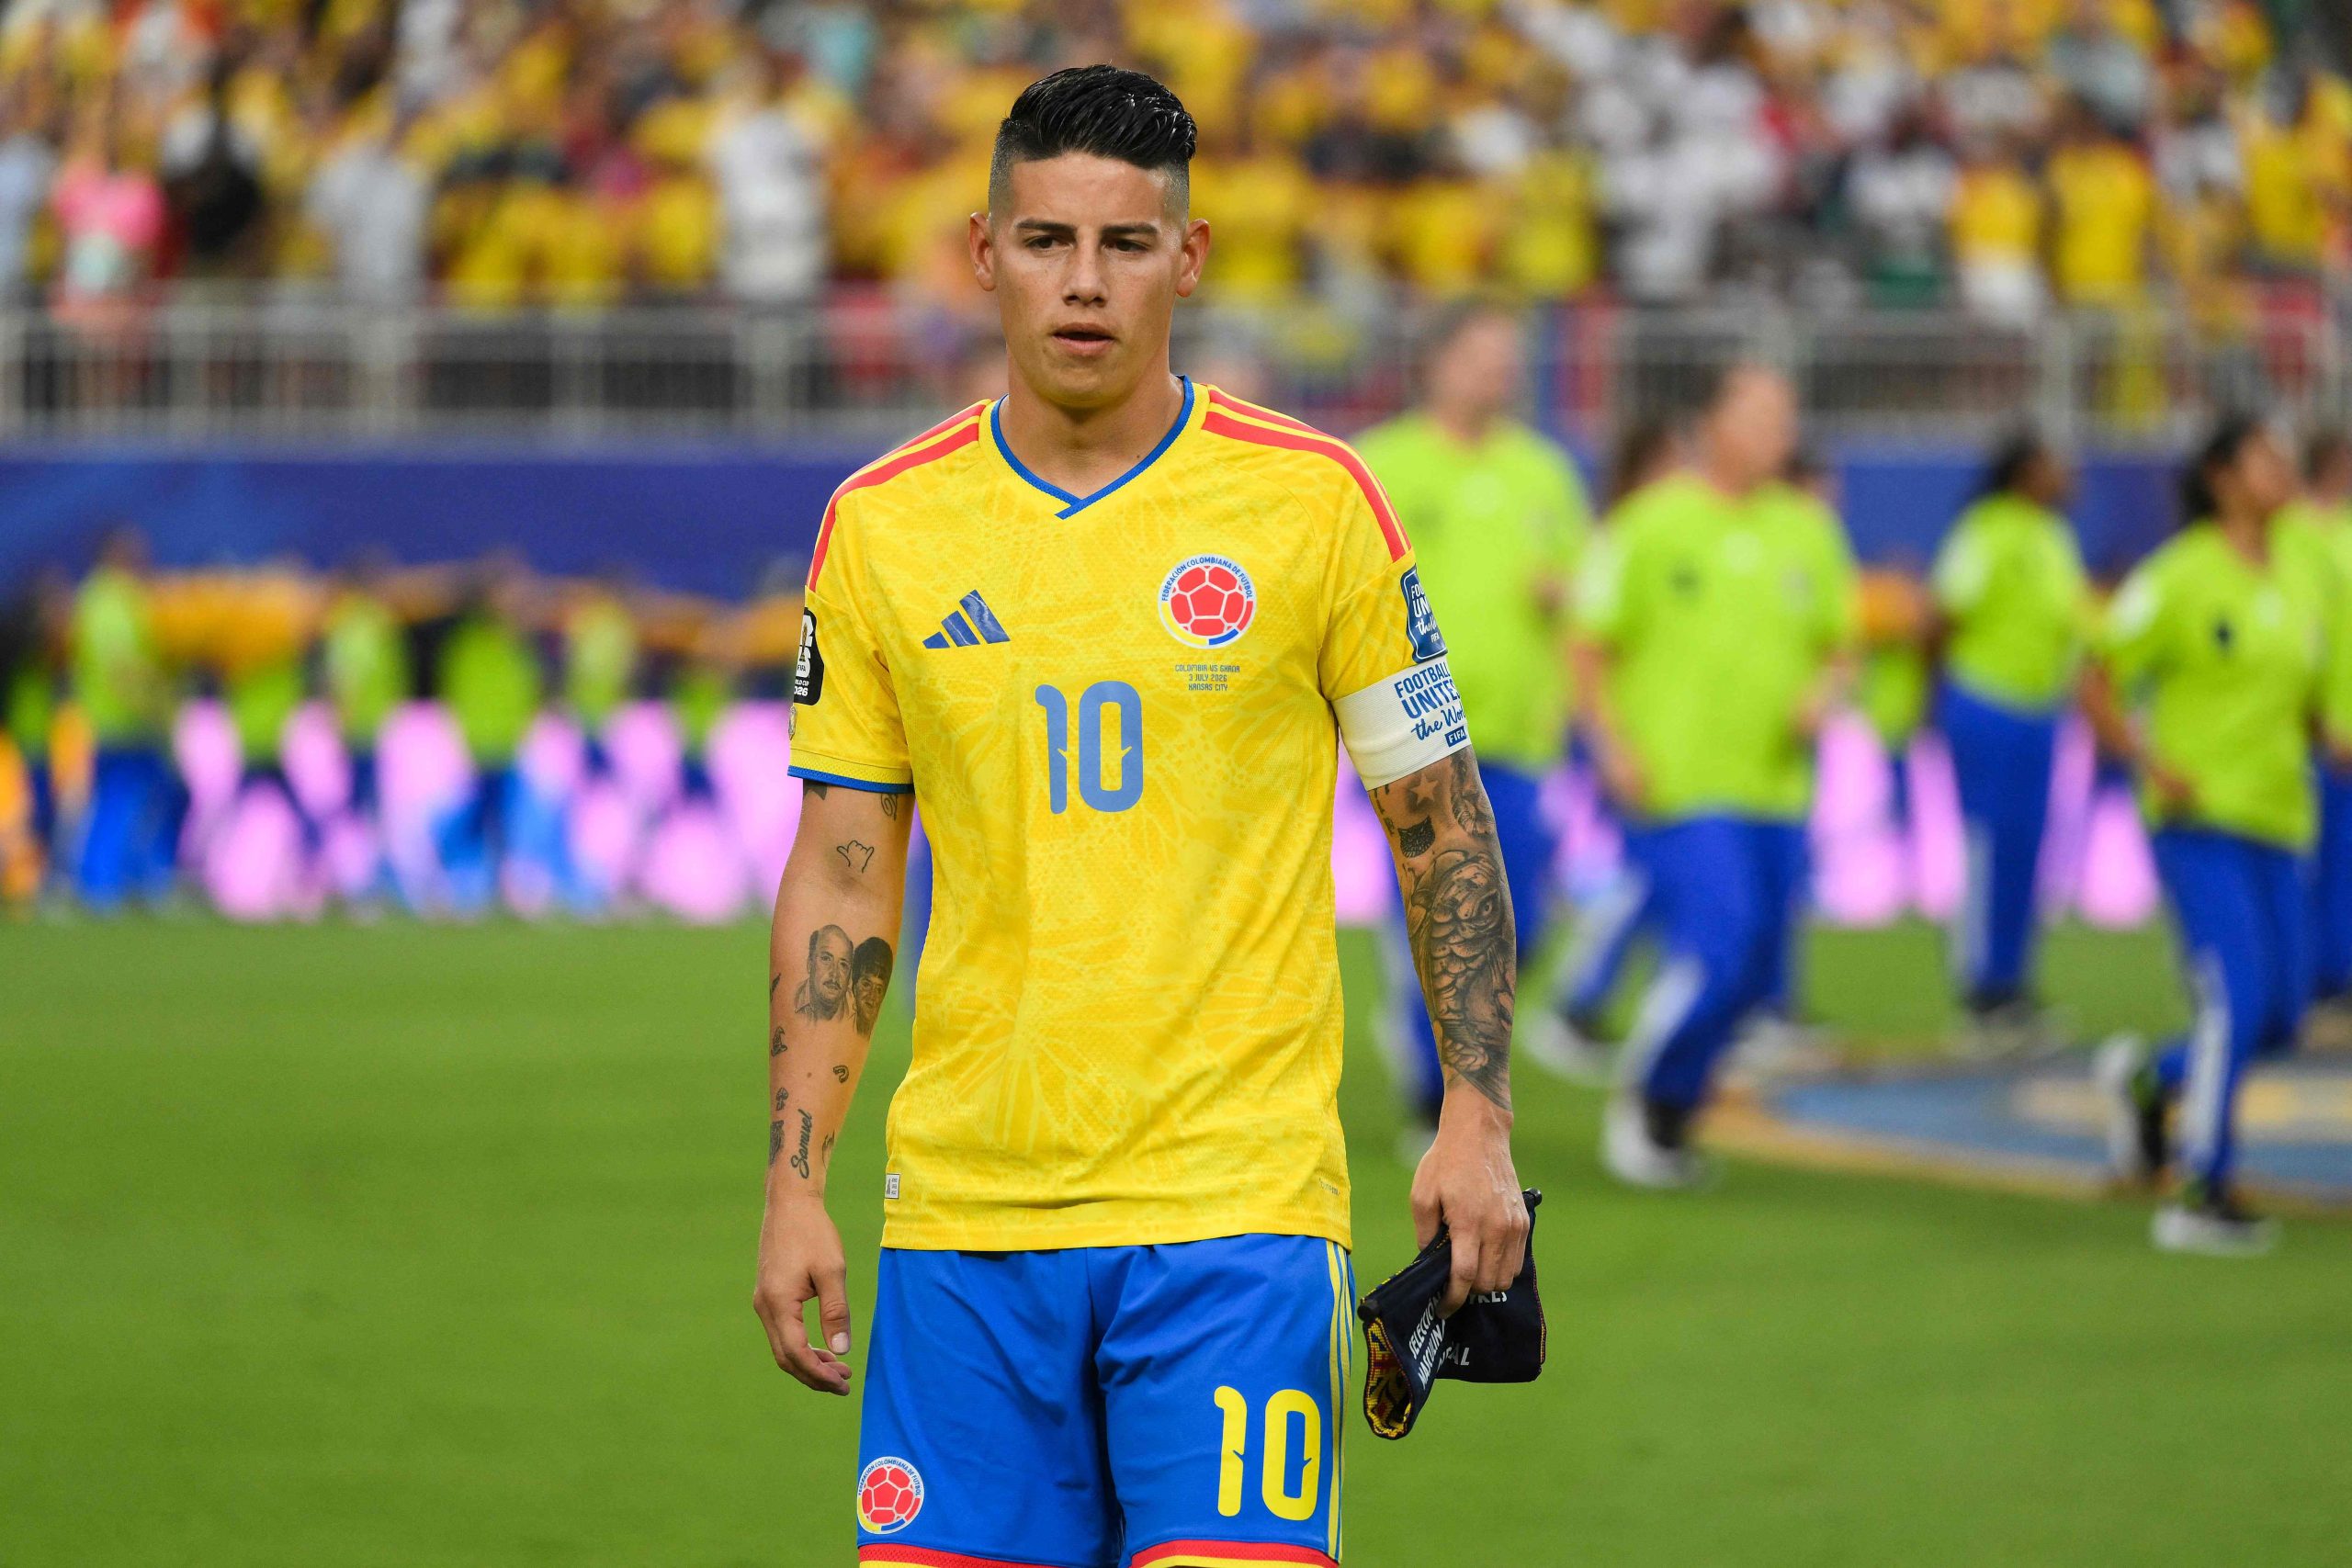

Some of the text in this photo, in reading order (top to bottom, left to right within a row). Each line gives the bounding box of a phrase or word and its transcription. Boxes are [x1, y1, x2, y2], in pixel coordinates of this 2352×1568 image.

[1186, 557, 1232, 570] COLOMBIANA
[1231, 566, 1240, 575] DE
[1194, 673, 1208, 682] JULY
[1211, 673, 1227, 682] 2026
[1219, 664, 1240, 673] GHANA
[1394, 661, 1451, 699] FOOTBALL
[1411, 718, 1443, 740] the
[1448, 730, 1466, 744] FIFA
[1035, 680, 1144, 815] 10
[790, 1109, 813, 1179] Samuel
[1214, 1385, 1321, 1521] 10
[875, 1459, 909, 1471] COLOMBIANA
